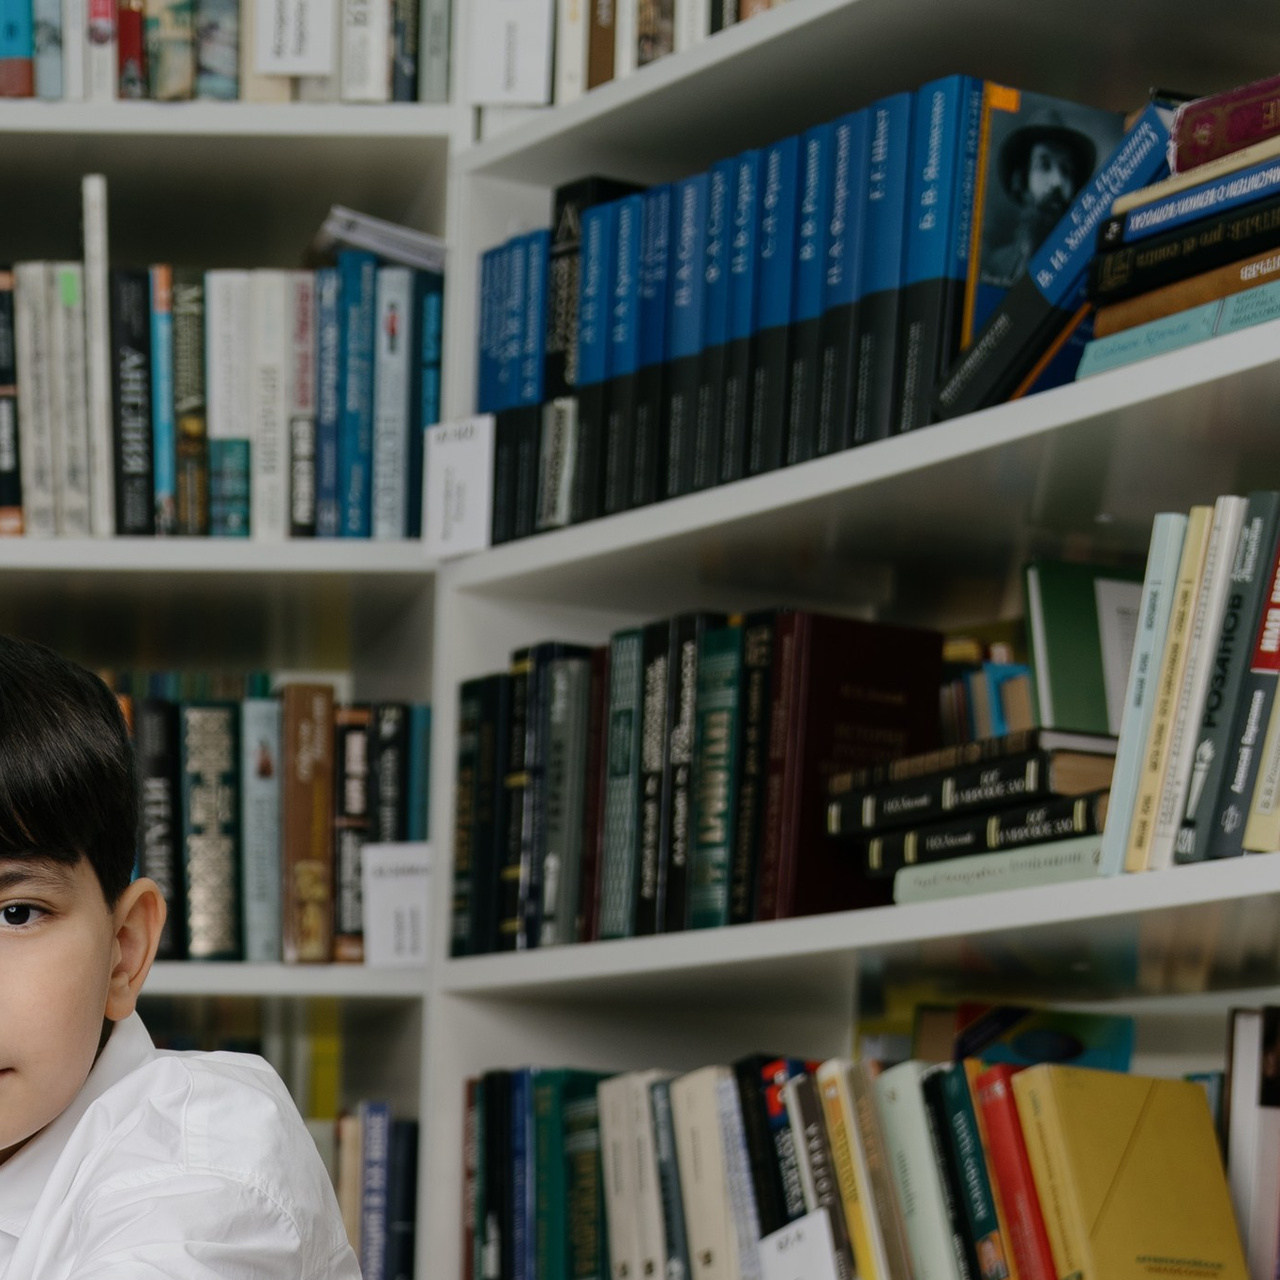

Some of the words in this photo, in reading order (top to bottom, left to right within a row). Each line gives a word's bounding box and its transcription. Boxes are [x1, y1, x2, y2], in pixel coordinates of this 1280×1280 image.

[1255, 604, 1280, 655] ИМЯ
[1199, 590, 1246, 730] РОЗАНОВ
[1240, 687, 1267, 747] Варламов
